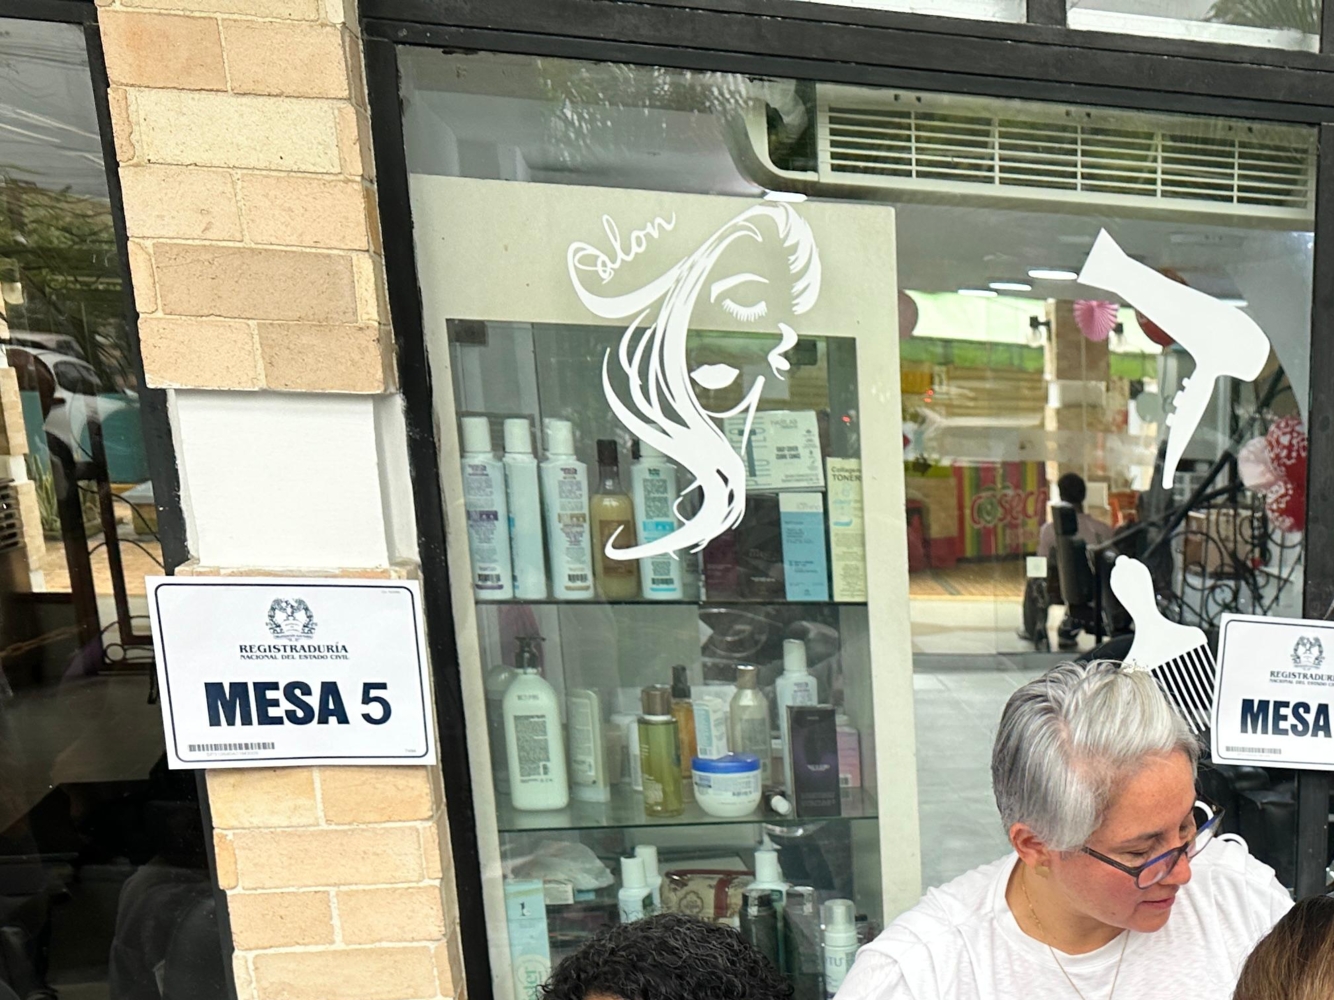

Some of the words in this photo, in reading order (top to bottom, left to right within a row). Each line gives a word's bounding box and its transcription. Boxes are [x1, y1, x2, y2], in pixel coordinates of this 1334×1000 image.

[239, 642, 348, 654] REGISTRADURÍA
[204, 680, 351, 727] MESA
[360, 682, 391, 726] 5
[1240, 698, 1332, 739] MESA
